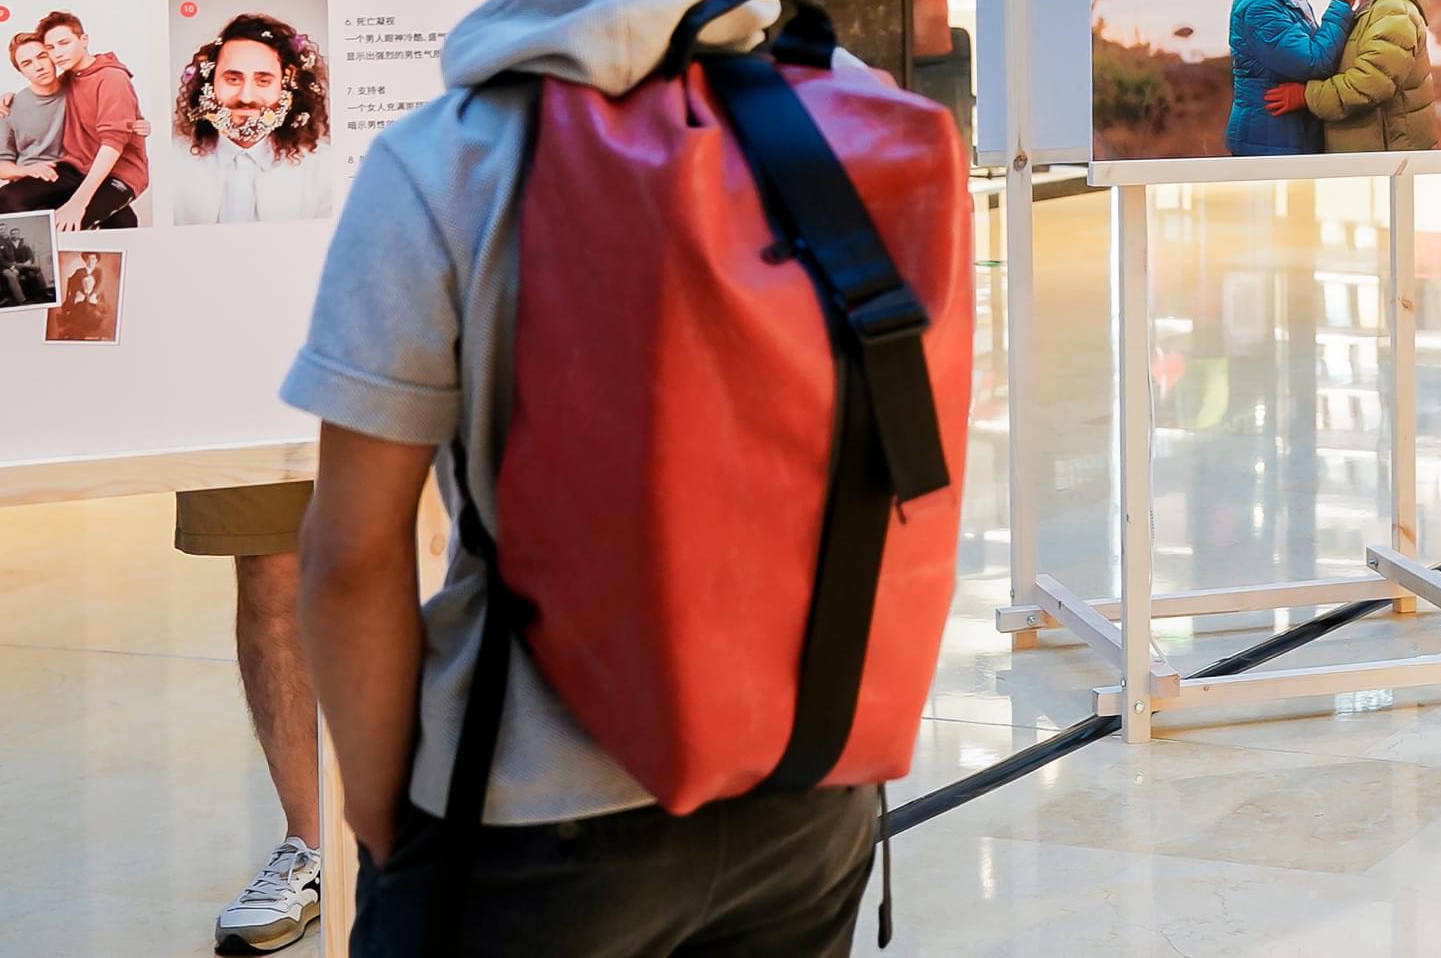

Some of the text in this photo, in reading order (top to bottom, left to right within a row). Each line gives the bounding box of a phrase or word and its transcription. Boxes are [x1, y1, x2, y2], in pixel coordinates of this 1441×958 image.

[347, 102, 425, 113] 一个女人充满
